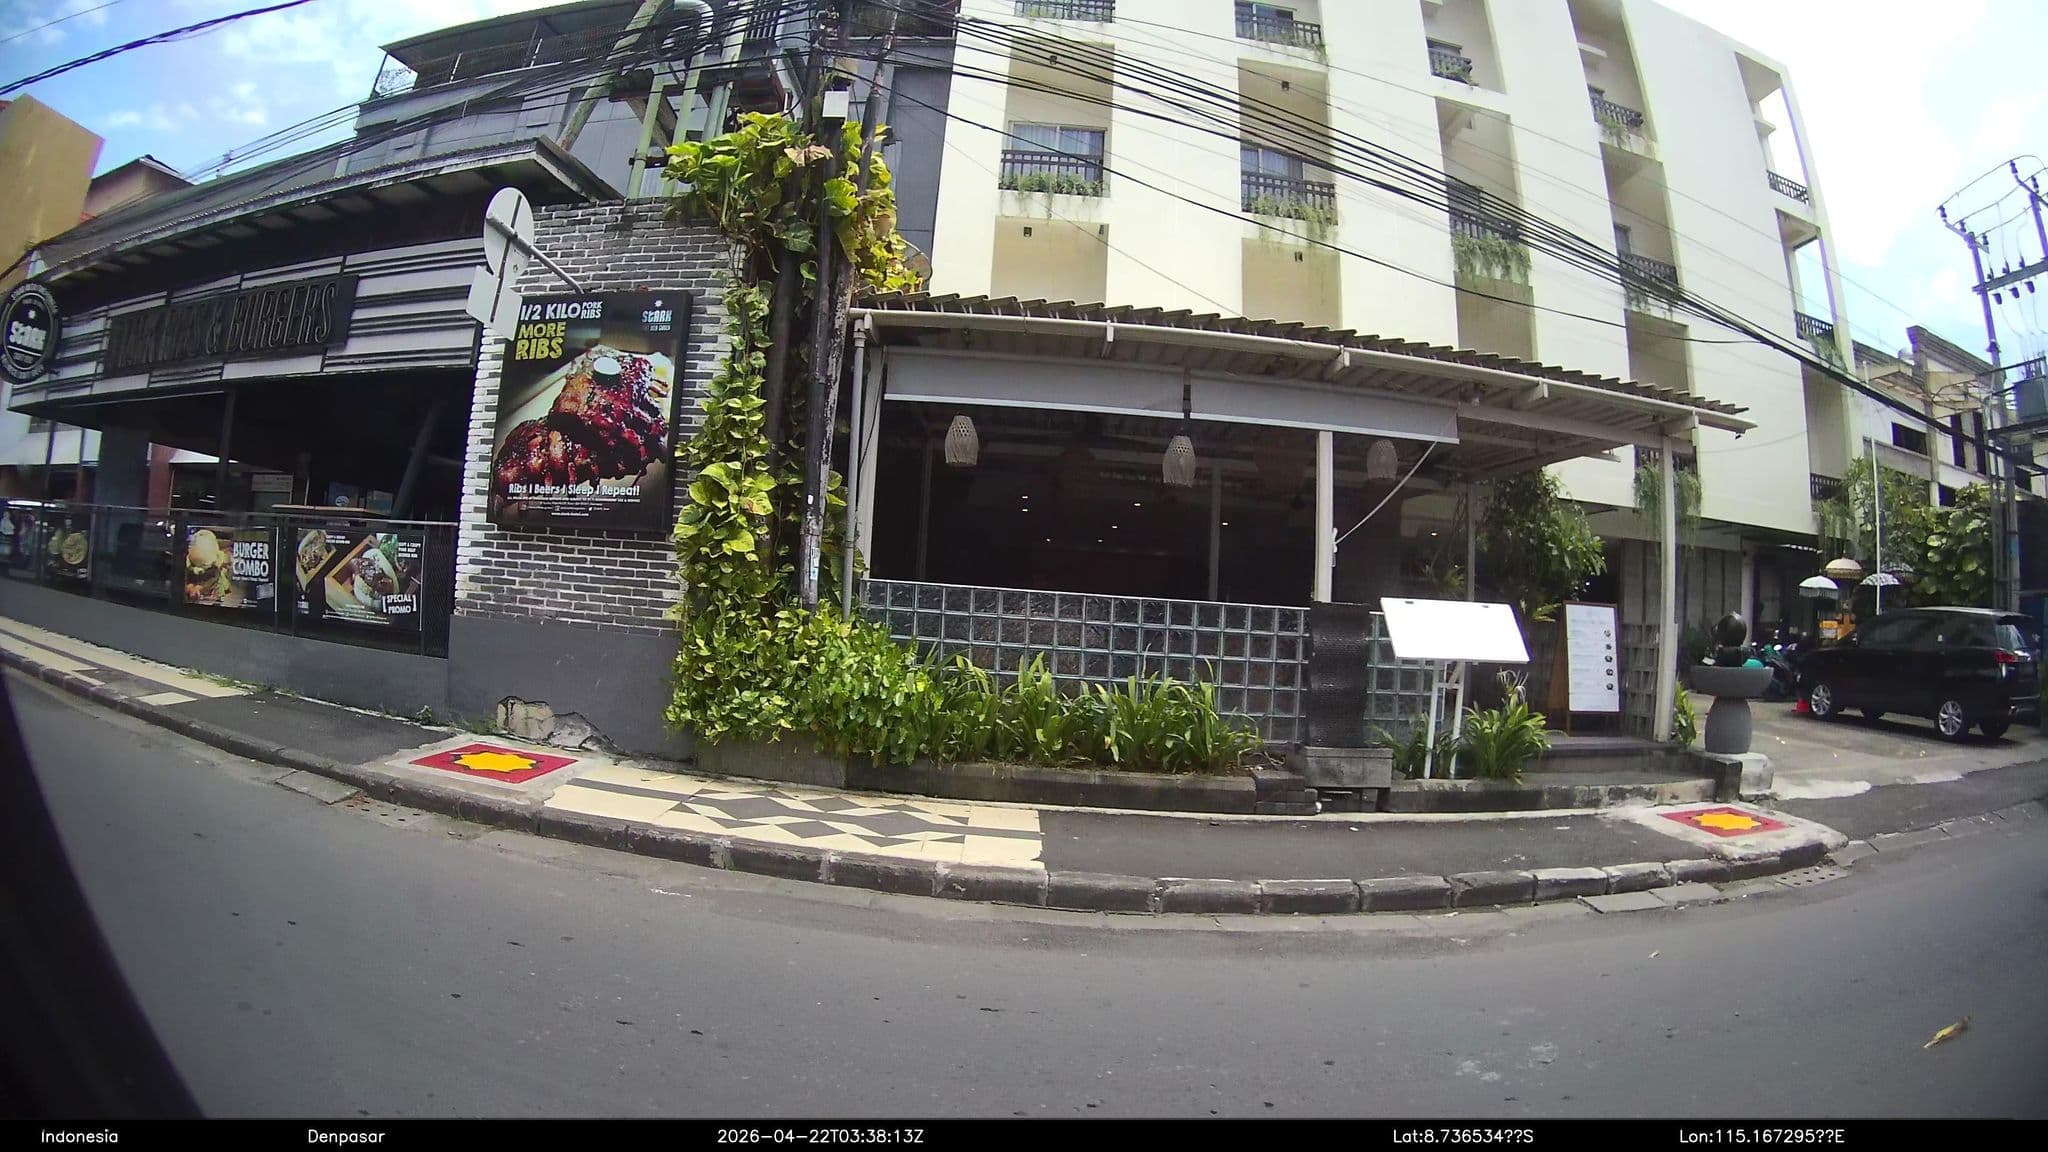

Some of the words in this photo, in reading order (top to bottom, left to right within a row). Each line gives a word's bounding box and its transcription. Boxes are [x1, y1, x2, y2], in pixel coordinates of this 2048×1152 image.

[520, 304, 541, 320] 1/2
[545, 302, 581, 319] KILO
[582, 301, 603, 309] PORK
[206, 300, 224, 355] &
[226, 282, 336, 352] BURGERS
[581, 309, 602, 319] RIBS
[518, 322, 567, 339] MORE
[515, 337, 564, 360] RIBS
[508, 483, 527, 494] Ribs
[534, 484, 560, 495] Beers
[567, 484, 594, 497] Sleep
[601, 485, 640, 498] Repeat!
[233, 542, 269, 560] BURGER
[233, 558, 269, 577] COMBO
[387, 594, 413, 604] SPECIAL
[388, 605, 412, 614] PROMO
